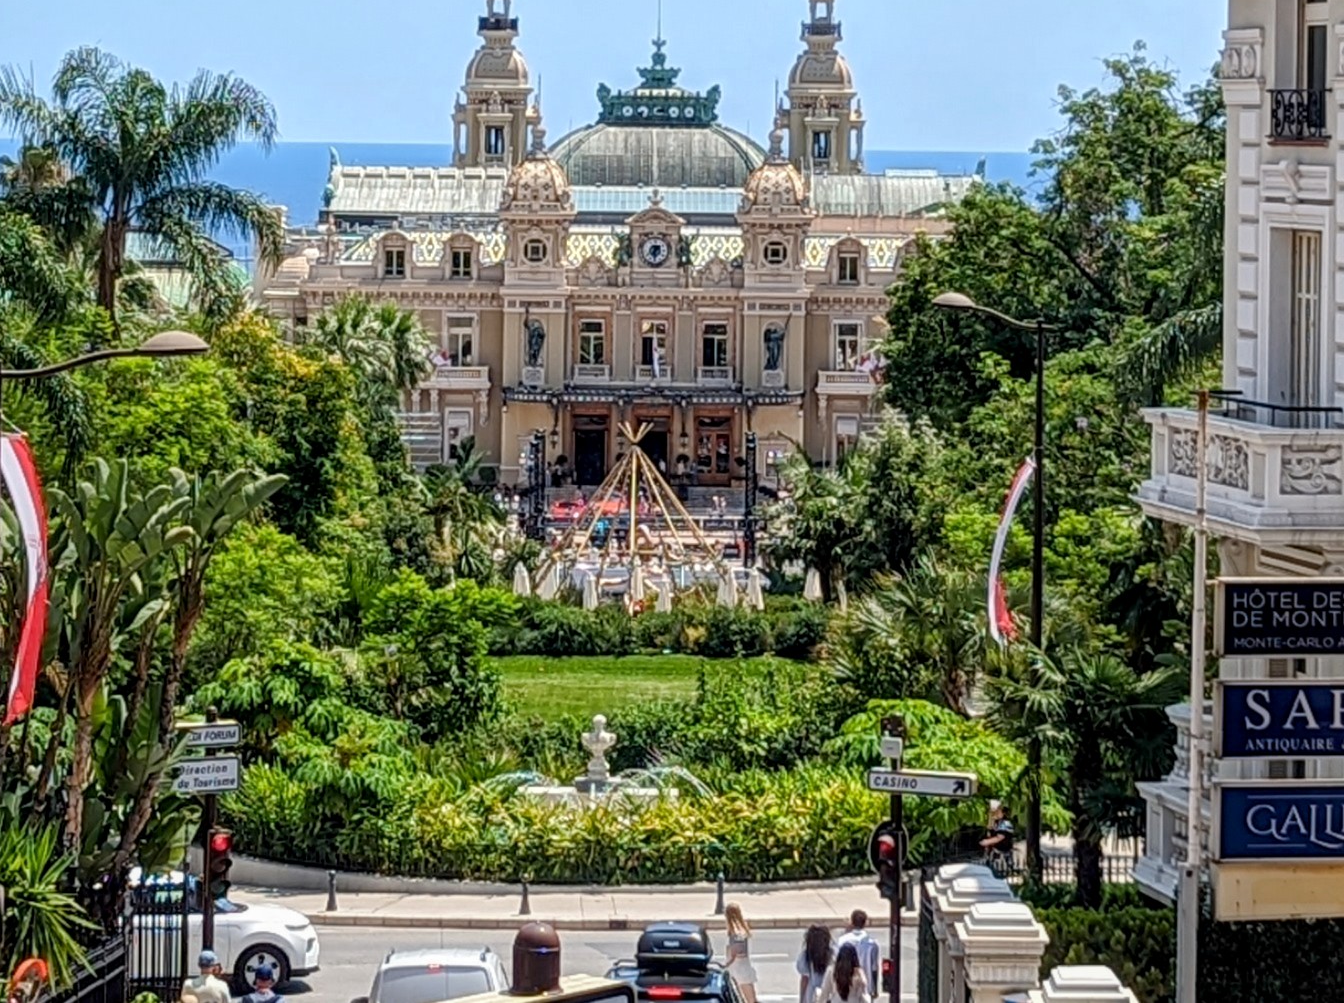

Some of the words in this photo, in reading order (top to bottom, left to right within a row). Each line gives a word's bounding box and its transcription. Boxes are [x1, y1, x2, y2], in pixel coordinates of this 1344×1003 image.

[1233, 588, 1305, 609] HÔTEL
[1233, 610, 1264, 628] DE
[1234, 637, 1335, 649] MONTE-CARLO
[1245, 738, 1334, 753] ANTIQUAIRE
[873, 776, 918, 789] CASINO
